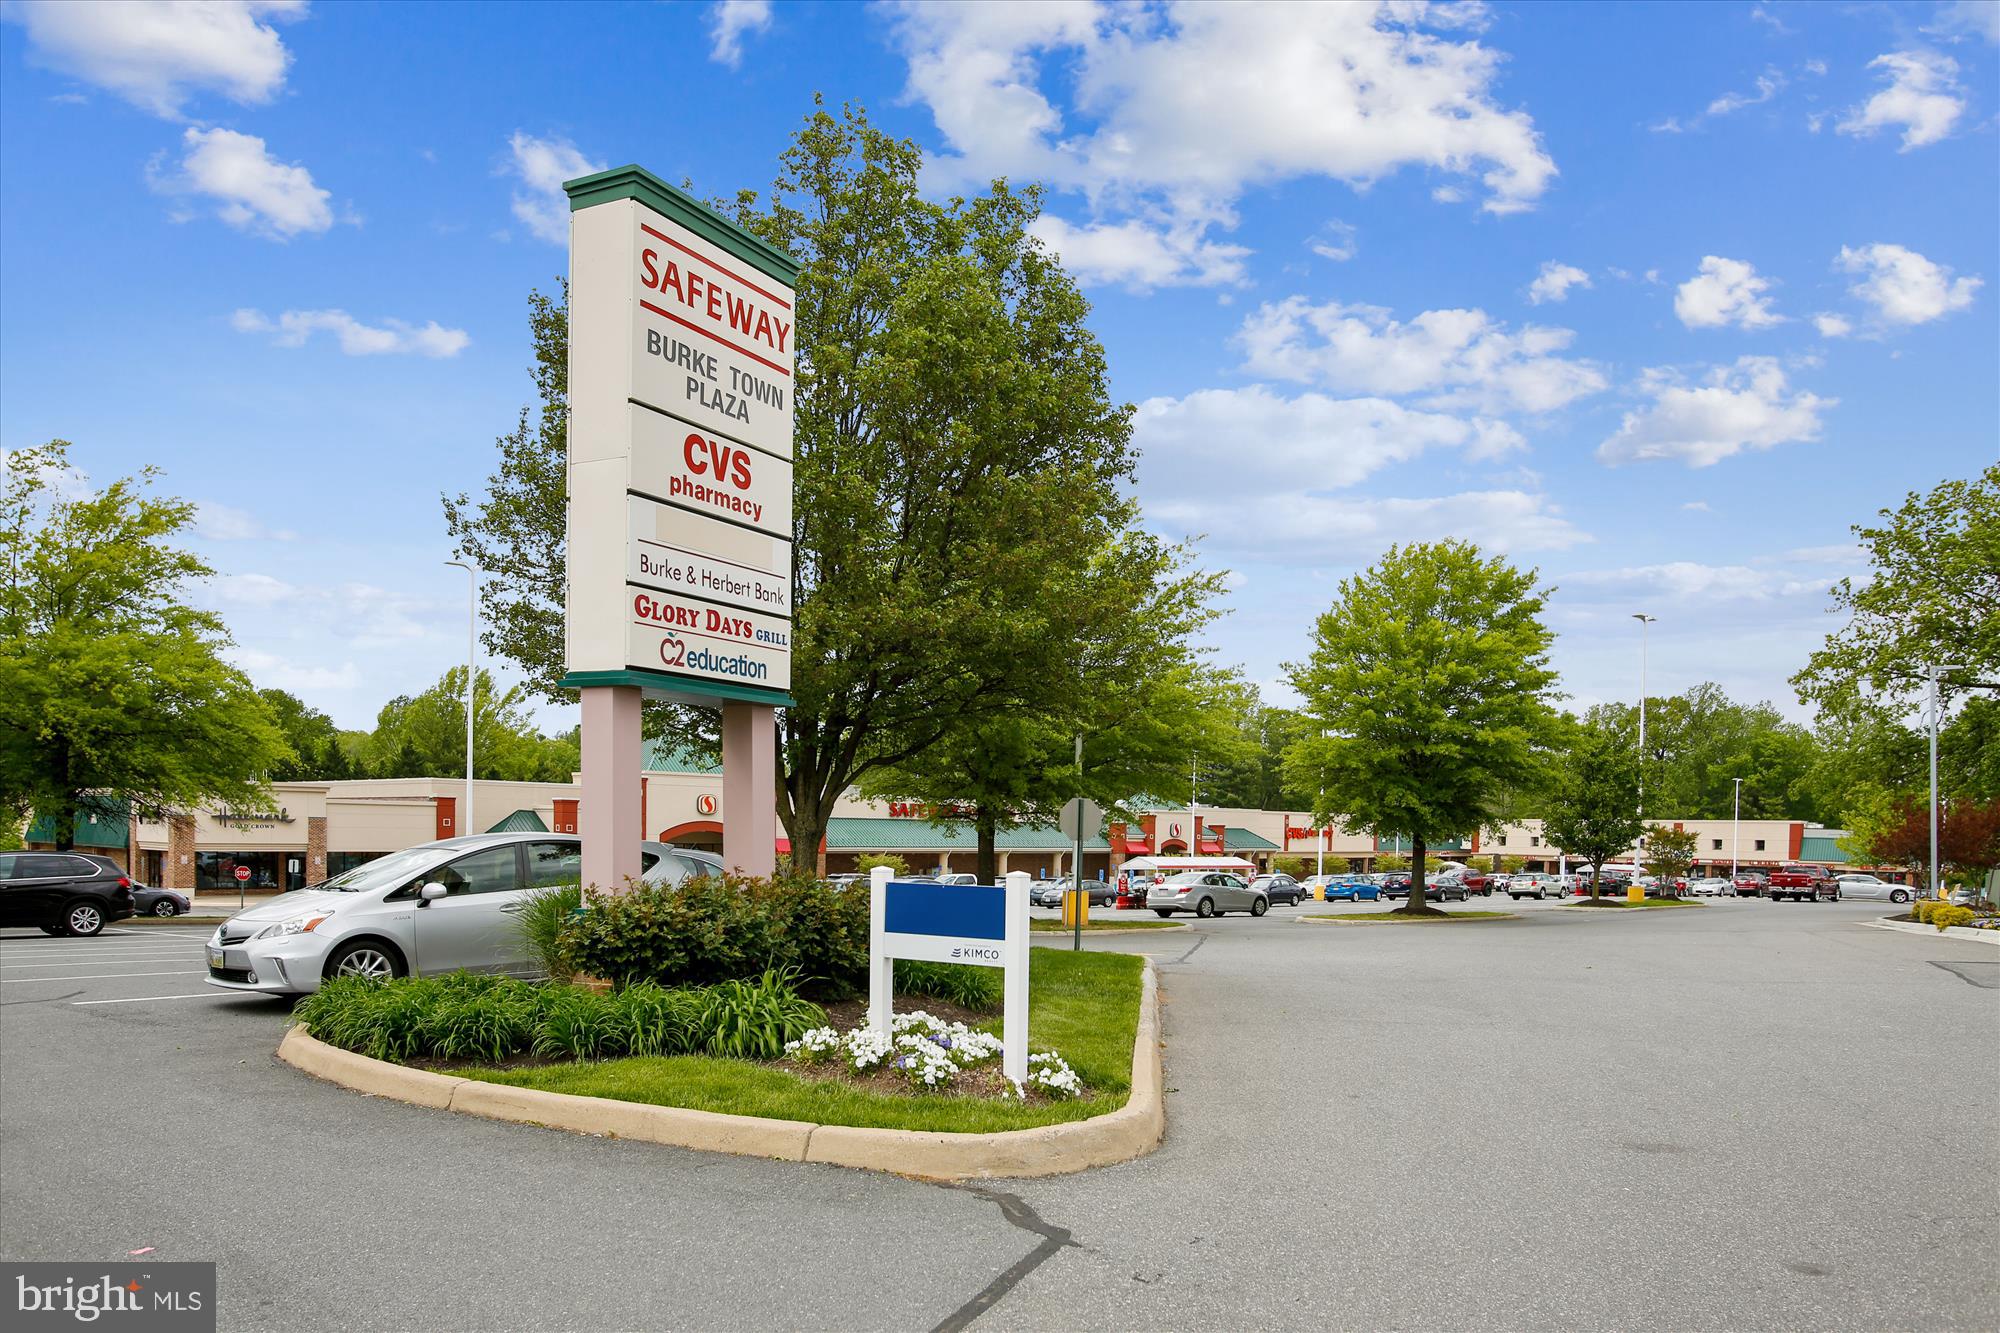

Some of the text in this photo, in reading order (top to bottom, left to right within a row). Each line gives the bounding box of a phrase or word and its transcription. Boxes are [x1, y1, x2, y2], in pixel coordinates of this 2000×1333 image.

[640, 248, 790, 353] SAFEWAY
[647, 328, 784, 411] BURKE TOWN
[686, 375, 750, 424] PLAZA
[683, 433, 752, 490] CVS
[669, 475, 762, 523] pharmacy
[640, 554, 785, 606] Burke & Herbert Bank
[634, 594, 788, 646] GLORY DAYS GRILL
[686, 648, 767, 680] education
[964, 948, 999, 960] KIMCO
